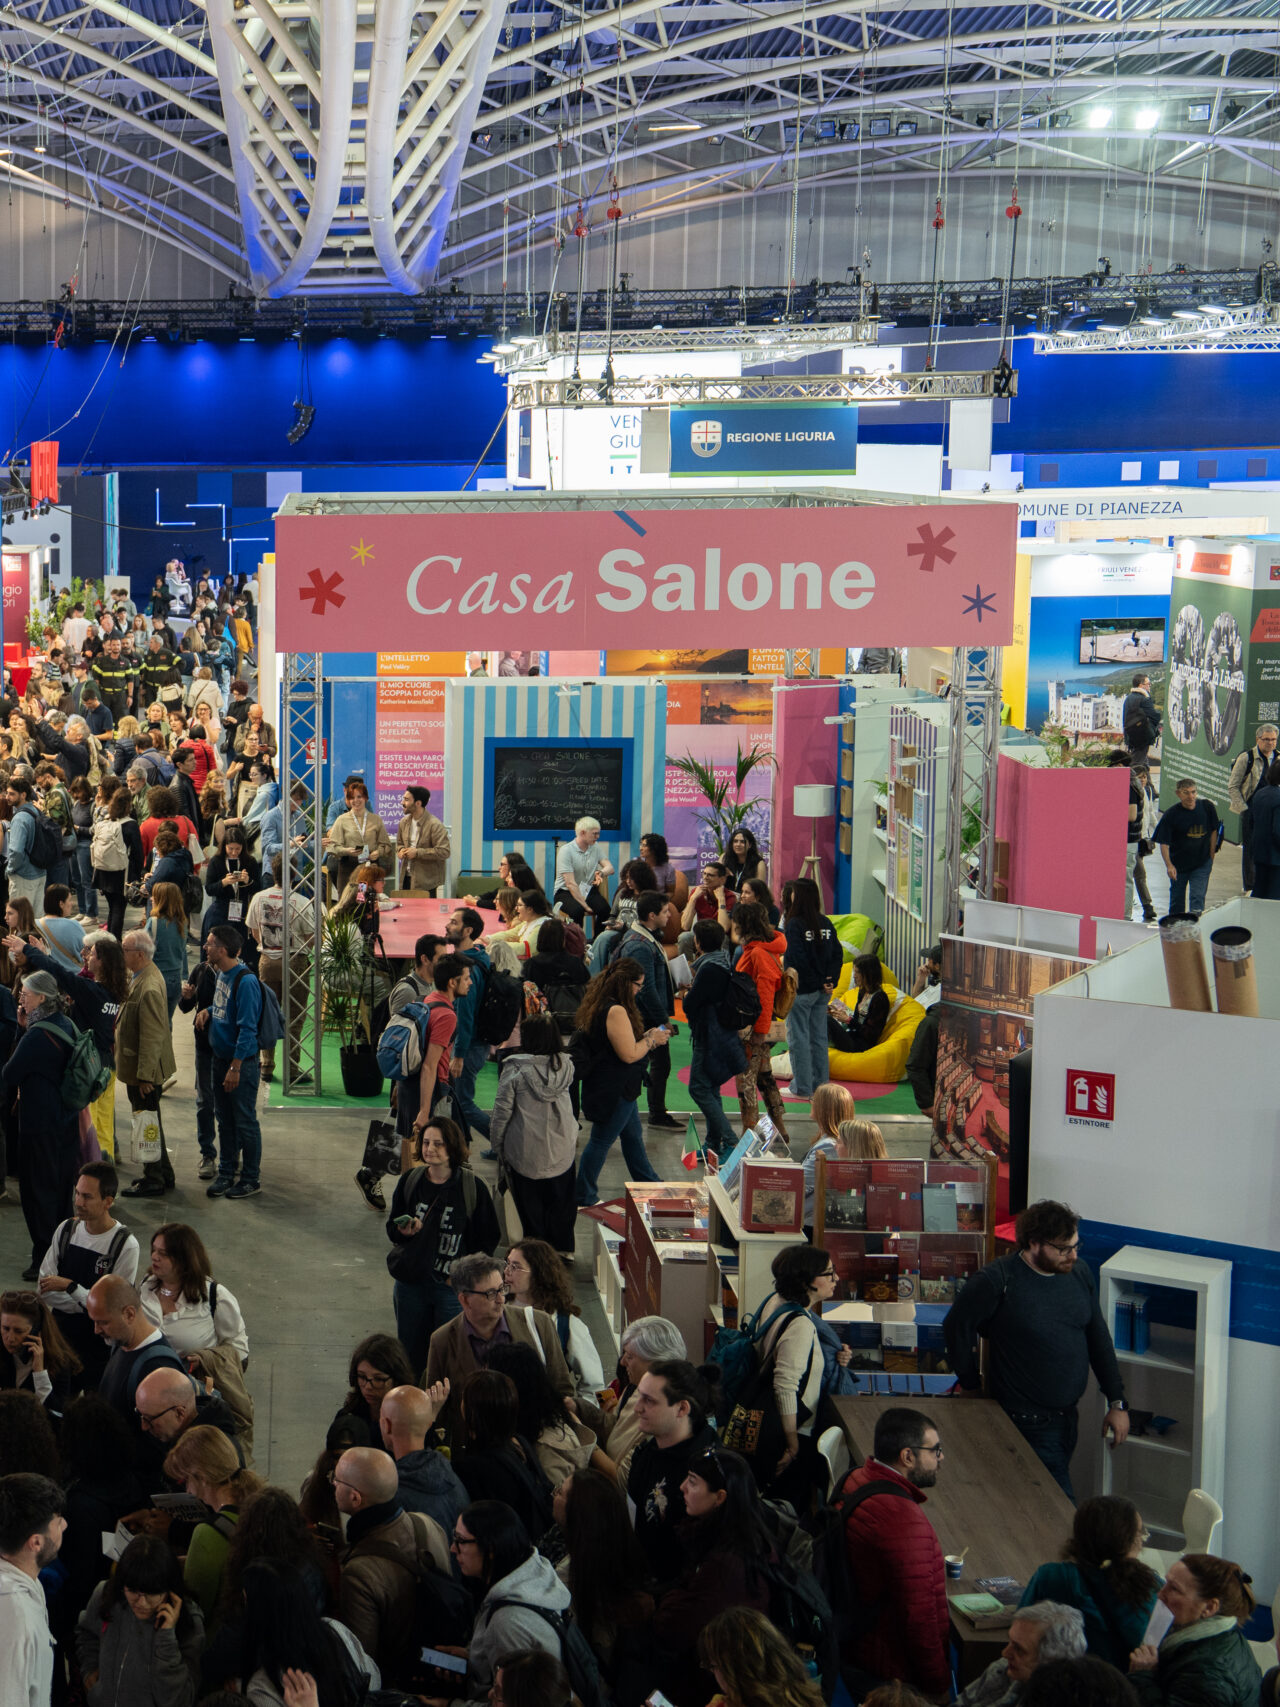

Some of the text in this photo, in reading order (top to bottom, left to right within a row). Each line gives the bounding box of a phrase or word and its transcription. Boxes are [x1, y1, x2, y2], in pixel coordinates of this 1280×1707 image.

[726, 431, 836, 443] REGIONE LIGURIA
[1075, 502, 1093, 516] DI
[1100, 500, 1184, 516] PIANEZZA
[406, 547, 877, 615] Casa Salone
[380, 654, 430, 662] L'INTELLETTO
[752, 654, 778, 662] FATTO
[380, 663, 392, 671] Paul
[379, 681, 432, 689] IL MIO CUORE
[379, 689, 413, 697] SCOPPIA
[413, 689, 422, 697] DI
[379, 727, 420, 736] DI FELICITÀ
[750, 733, 765, 741] UN
[379, 754, 403, 762] ESISTE
[404, 754, 422, 762] UNA
[379, 762, 393, 770] PER
[393, 762, 439, 770] DESCRIVERE
[805, 929, 832, 941] SFF
[1068, 1117, 1110, 1129] ESTINTORE
